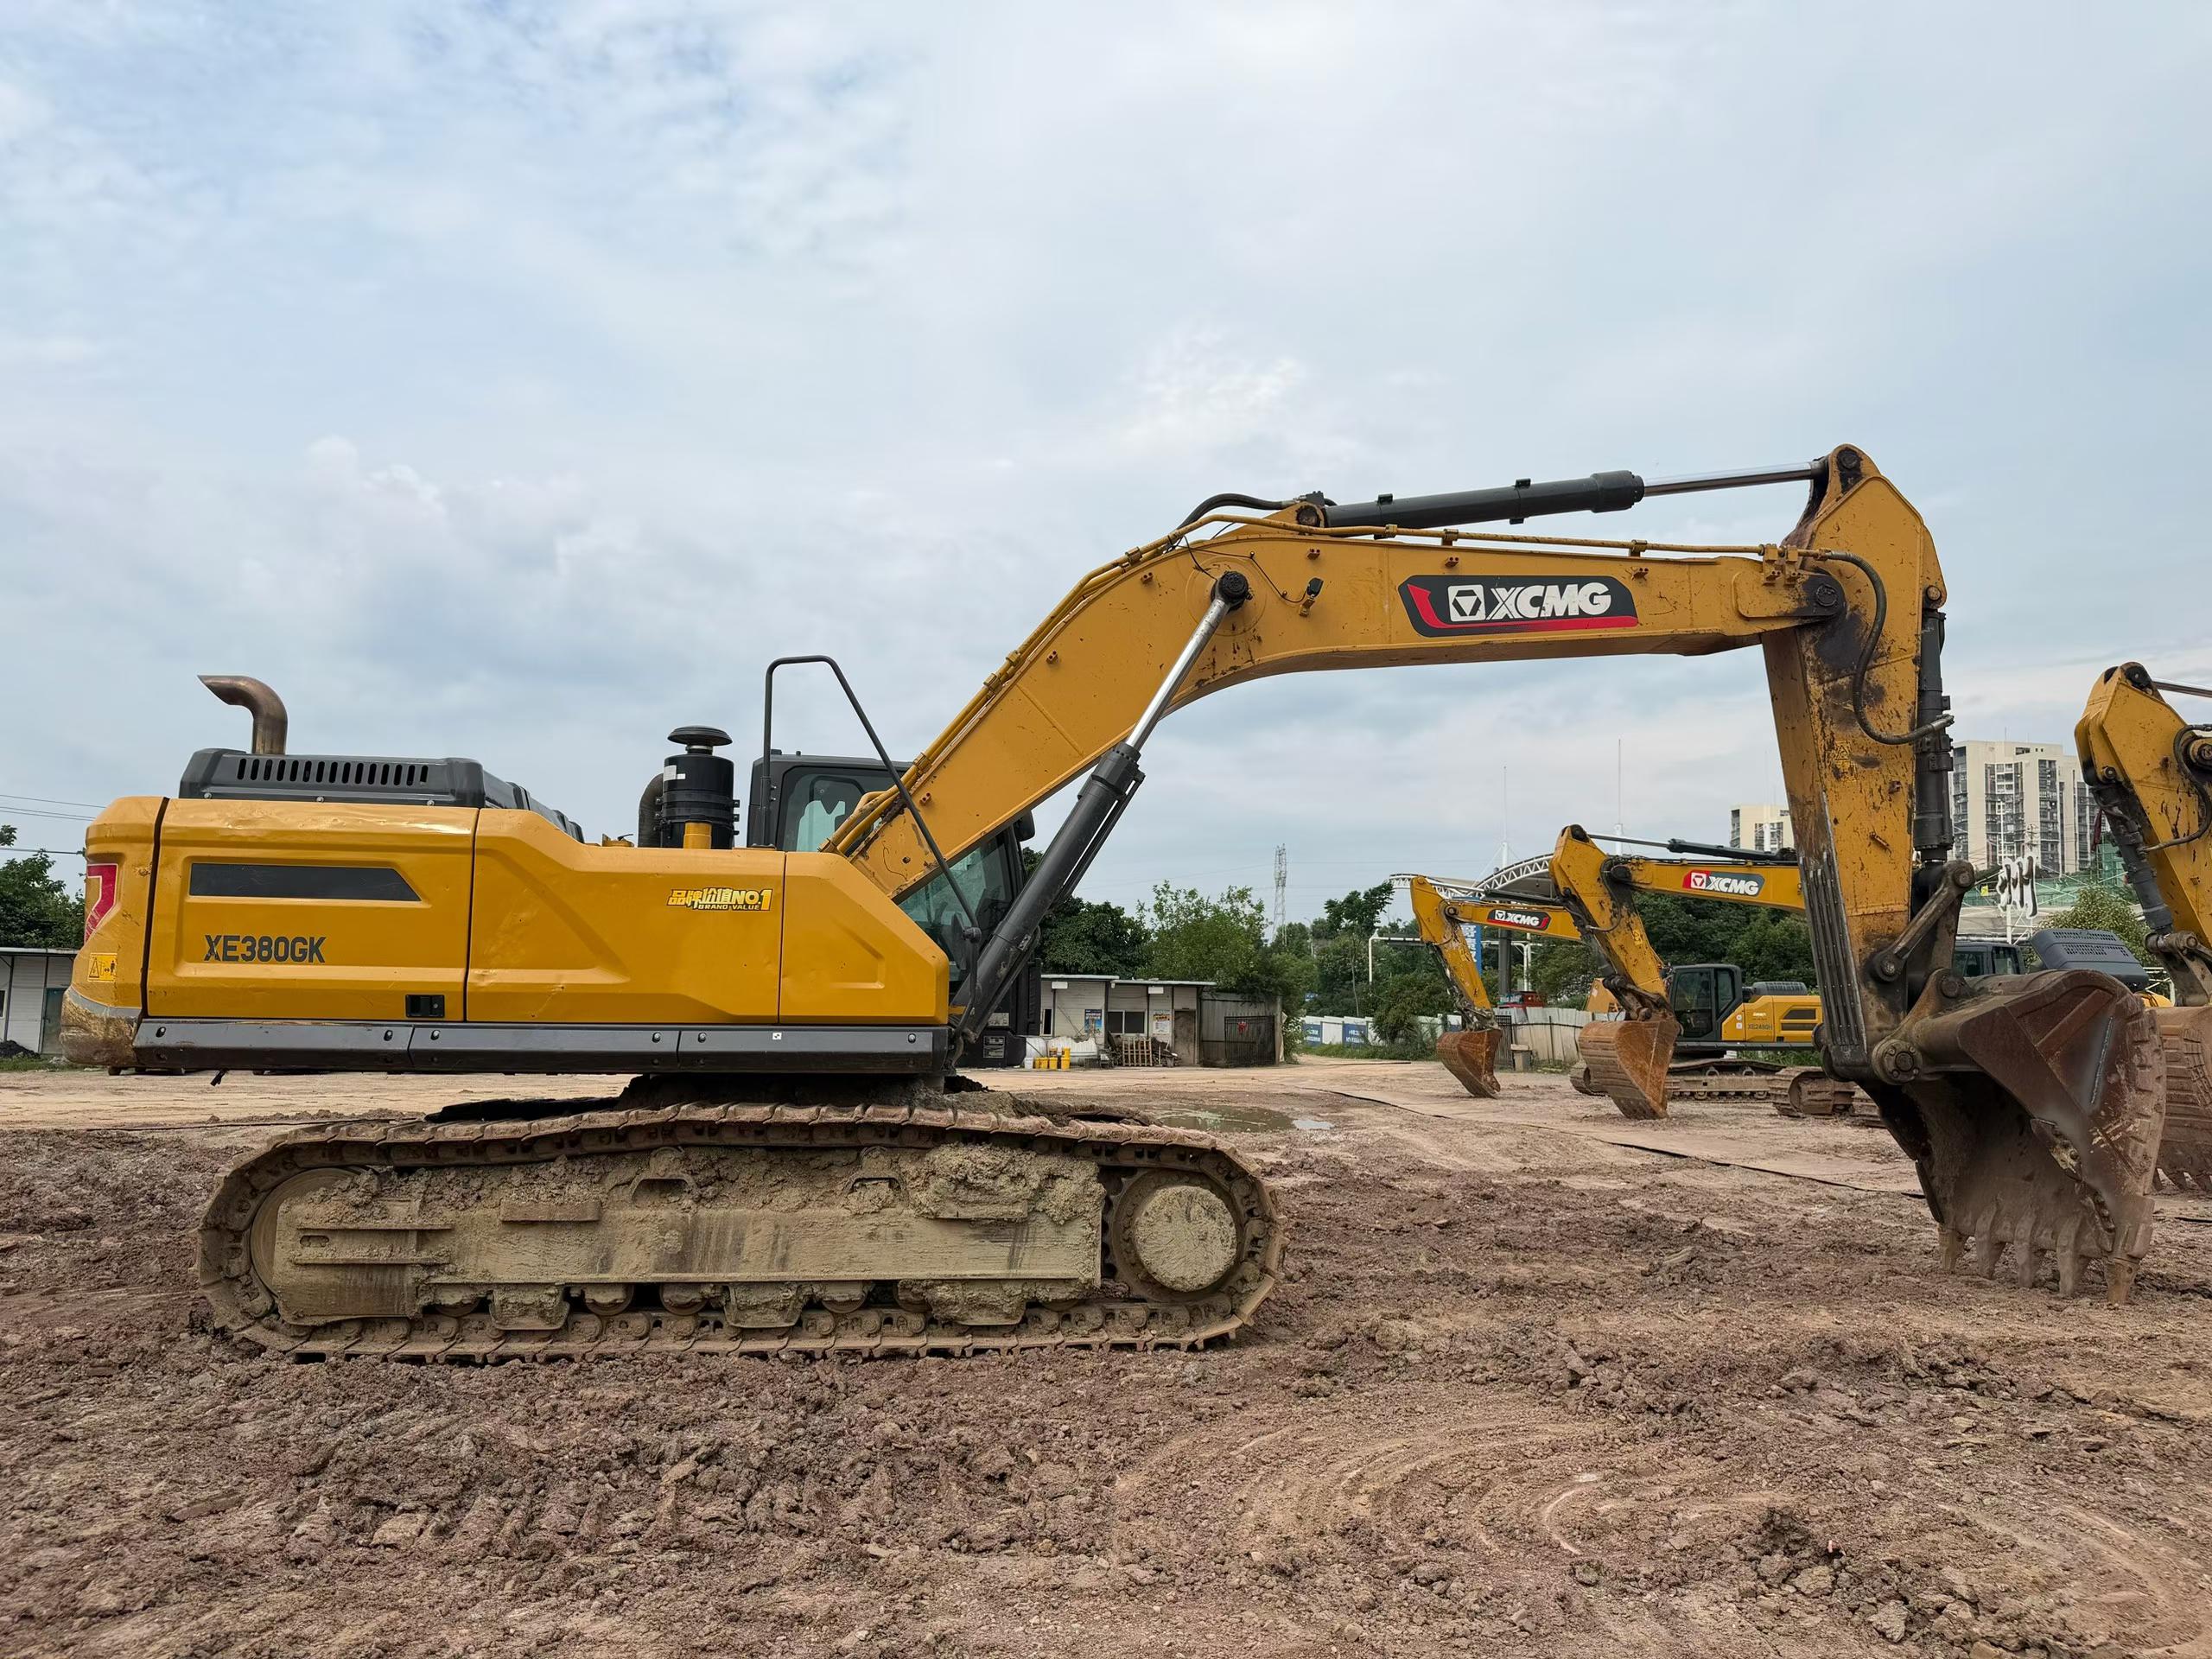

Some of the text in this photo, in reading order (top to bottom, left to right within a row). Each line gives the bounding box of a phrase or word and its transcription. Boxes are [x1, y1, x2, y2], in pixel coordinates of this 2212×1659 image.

[1485, 582, 1611, 620] XCMG
[1705, 875, 1759, 896] XCMG
[1505, 912, 1540, 926] XCMG
[204, 935, 327, 963] XE380GK
